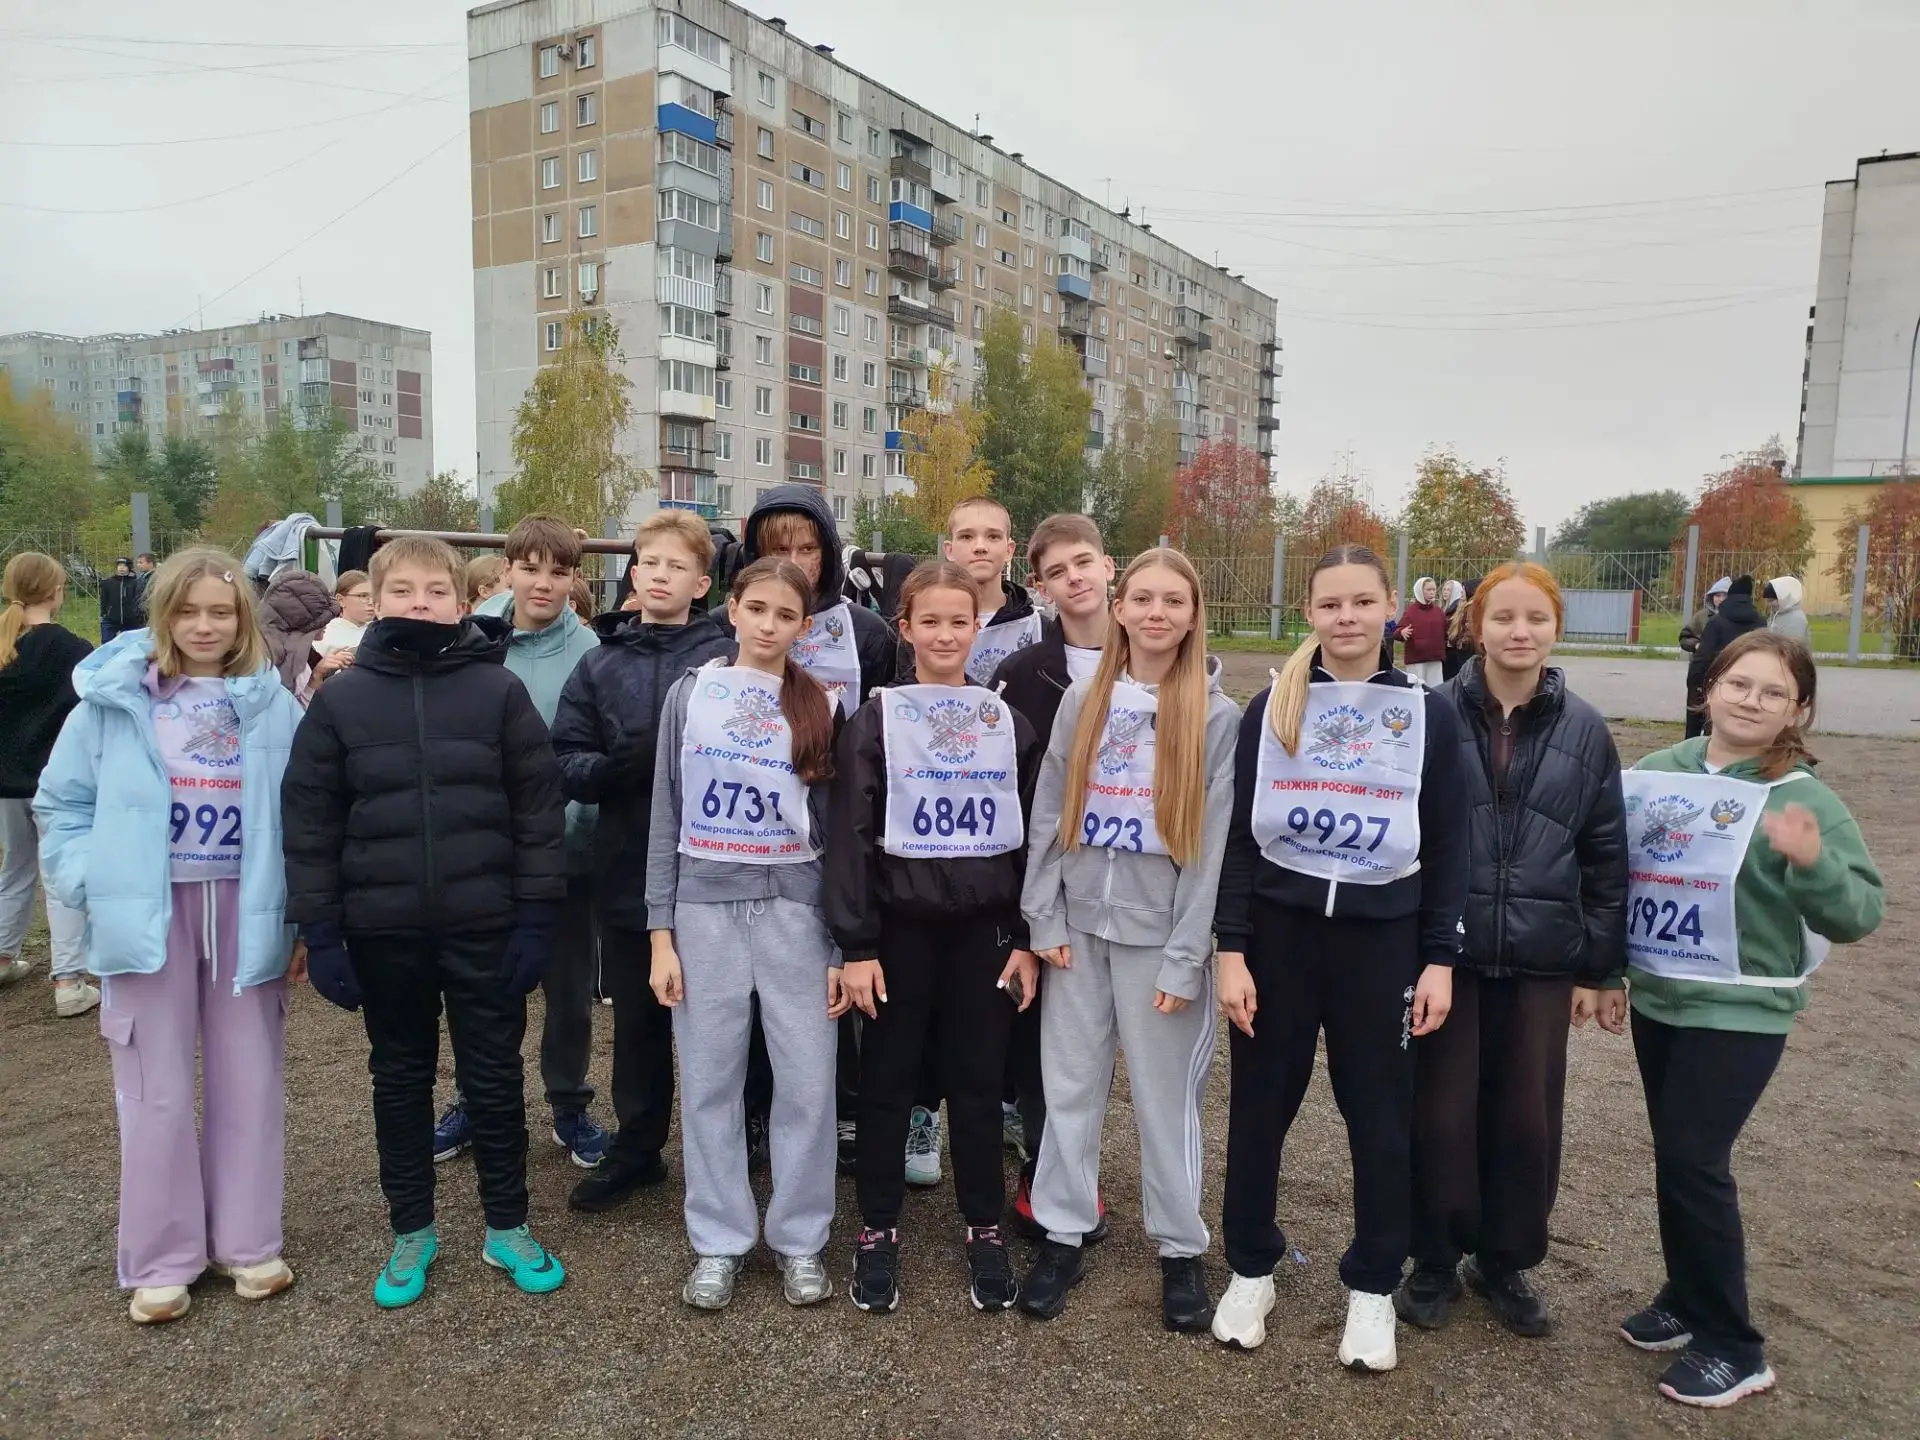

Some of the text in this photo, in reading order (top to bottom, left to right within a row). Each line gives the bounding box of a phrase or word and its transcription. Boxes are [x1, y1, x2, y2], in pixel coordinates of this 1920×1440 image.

[740, 686, 783, 708] ЛЫЖНЯ
[192, 698, 234, 713] ЛЫЖН
[929, 699, 972, 714] ЛЫЖНЯ
[1318, 704, 1365, 723] ЛЫЖНЯ
[727, 730, 773, 749] РОССИИ
[935, 750, 977, 764] РОССИИ
[1312, 755, 1364, 771] РОССИИ
[1272, 780, 1318, 791] ЛЫЖНЯ
[1321, 782, 1367, 796] РОССИИ
[1376, 789, 1404, 801] 2017
[702, 778, 783, 824] 6731
[1649, 795, 1695, 811] ЛЫЖНЯ
[912, 796, 996, 837] 6849
[691, 820, 797, 837] Кемеровская область
[1287, 806, 1391, 853] 9927
[1669, 831, 1694, 842] 2017
[727, 842, 770, 854] РОССИИ
[902, 841, 1008, 853] Кемеровская область
[169, 852, 230, 862] меровская
[1694, 880, 1720, 893] 2017
[1671, 949, 1720, 962] область
